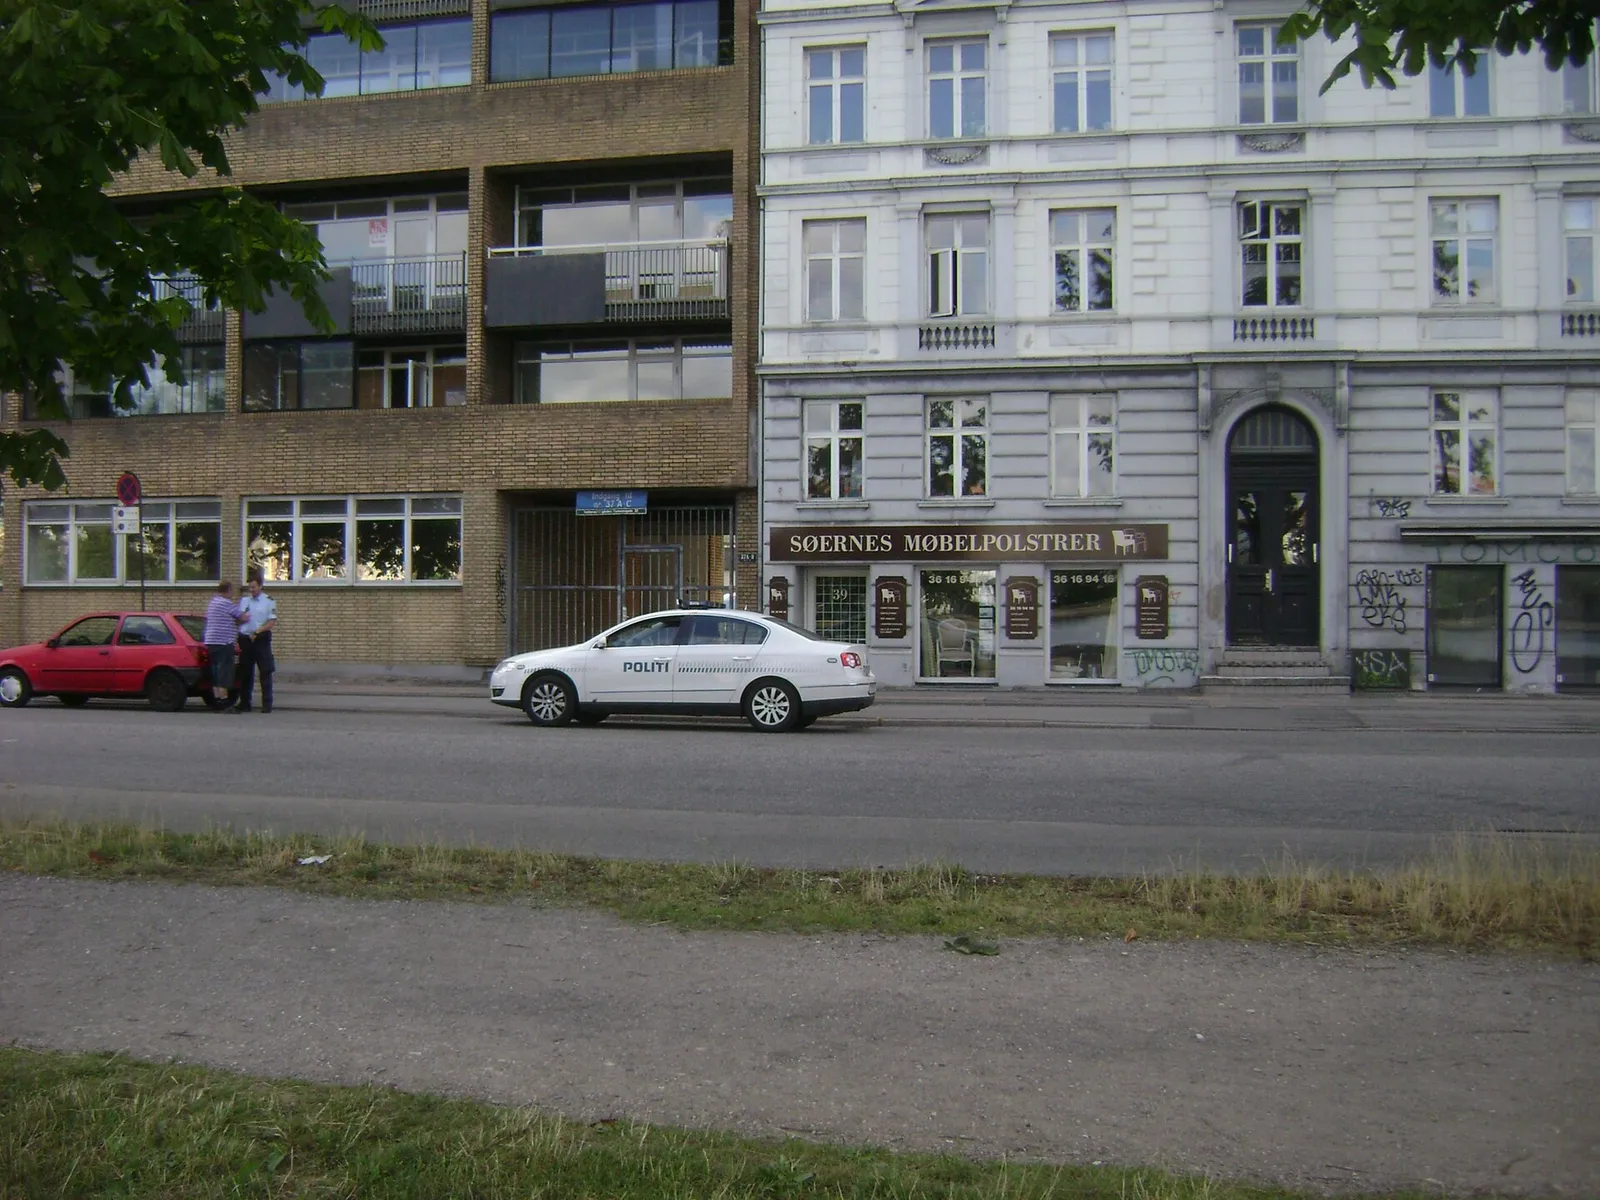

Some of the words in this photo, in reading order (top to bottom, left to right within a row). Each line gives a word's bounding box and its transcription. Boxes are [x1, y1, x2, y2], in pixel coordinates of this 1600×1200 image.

[790, 534, 893, 553] SØERNES
[903, 533, 1101, 553] MØBELPOLSTRER
[928, 575, 942, 584] 36
[945, 575, 957, 584] 16
[1053, 575, 1068, 584] 36
[1070, 575, 1083, 584] 16
[1085, 575, 1100, 584] 94
[832, 588, 848, 601] 39
[623, 662, 669, 673] POLITI
